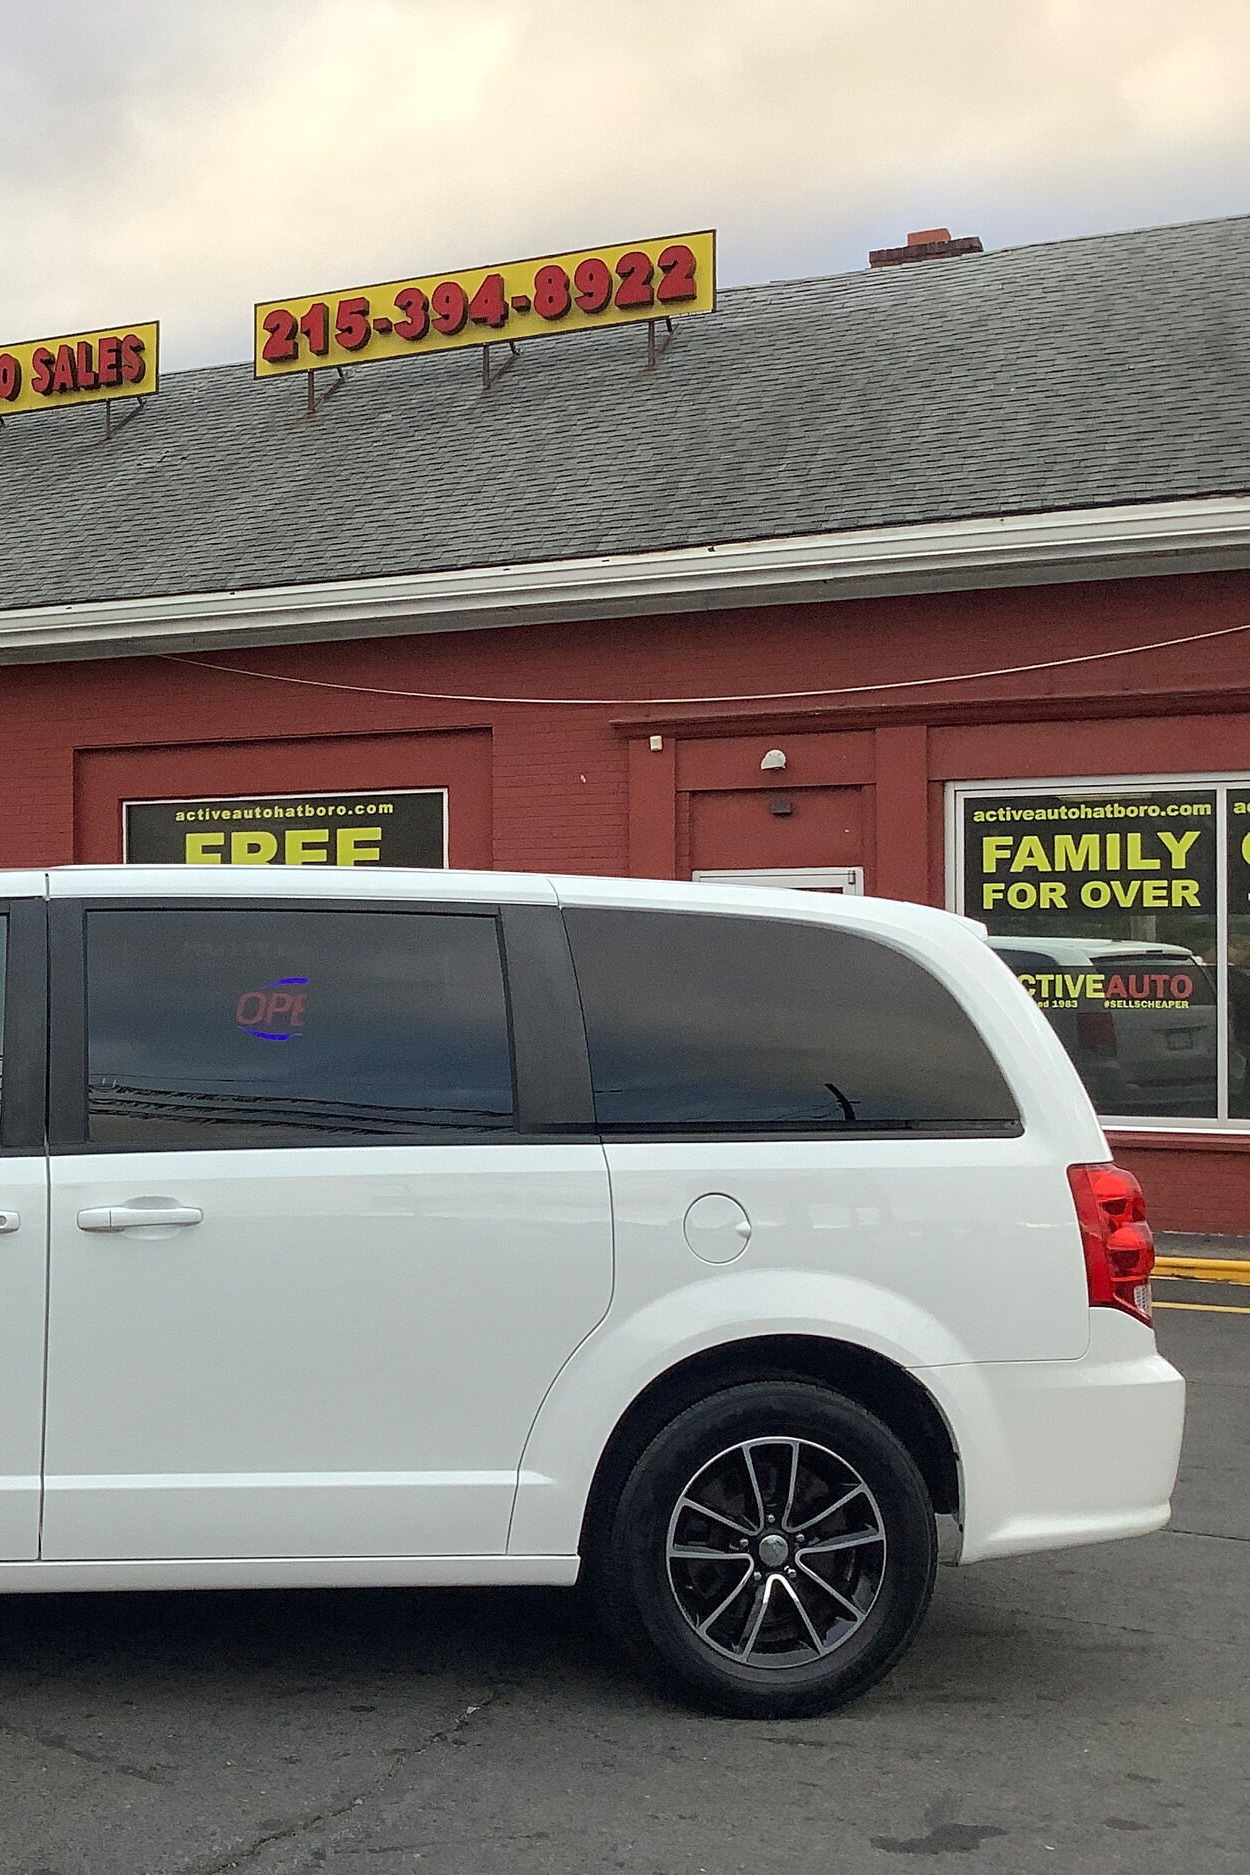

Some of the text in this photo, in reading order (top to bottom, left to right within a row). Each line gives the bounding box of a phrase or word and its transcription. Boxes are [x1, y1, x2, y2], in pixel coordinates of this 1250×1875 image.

[262, 244, 698, 363] 215-394-8922
[31, 334, 146, 395] SALES
[175, 802, 393, 822] activeautohatboro.com
[973, 803, 1212, 822] activeautohatboro.com
[982, 831, 1201, 874] FAMILY
[982, 879, 1201, 910] FOR OVER
[1018, 974, 1193, 999] CTIVEAUTO
[1052, 1000, 1078, 1008] 1983
[1104, 1000, 1189, 1009] #SELLSCHEAPER
